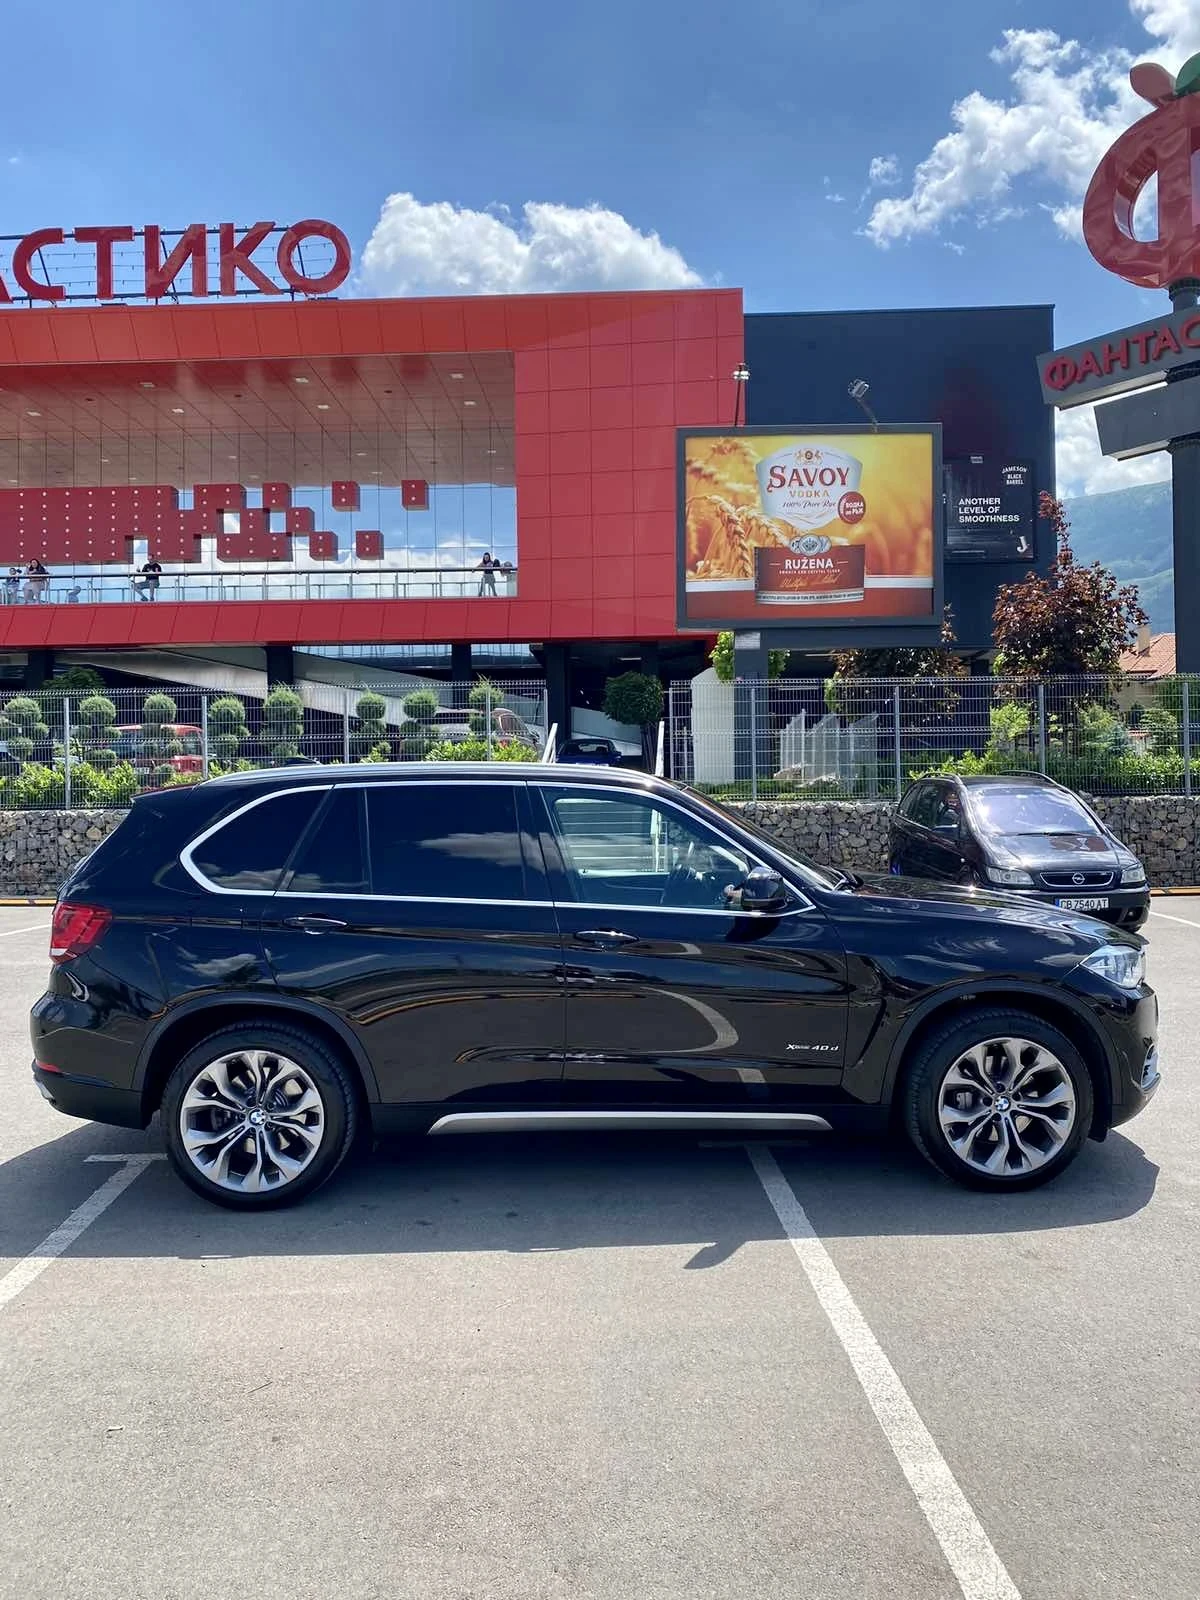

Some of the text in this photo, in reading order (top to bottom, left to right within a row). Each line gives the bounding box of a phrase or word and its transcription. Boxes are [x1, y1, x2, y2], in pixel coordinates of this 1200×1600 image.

[0, 218, 352, 304] СТИКО
[1002, 466, 1027, 474] JAMESON
[766, 464, 850, 493] SAVOY
[958, 506, 1001, 514] LEVEL OF
[958, 515, 1020, 523] SMOOTHNESS
[784, 557, 834, 570] RUŽENA
[1074, 900, 1094, 909] 7540
